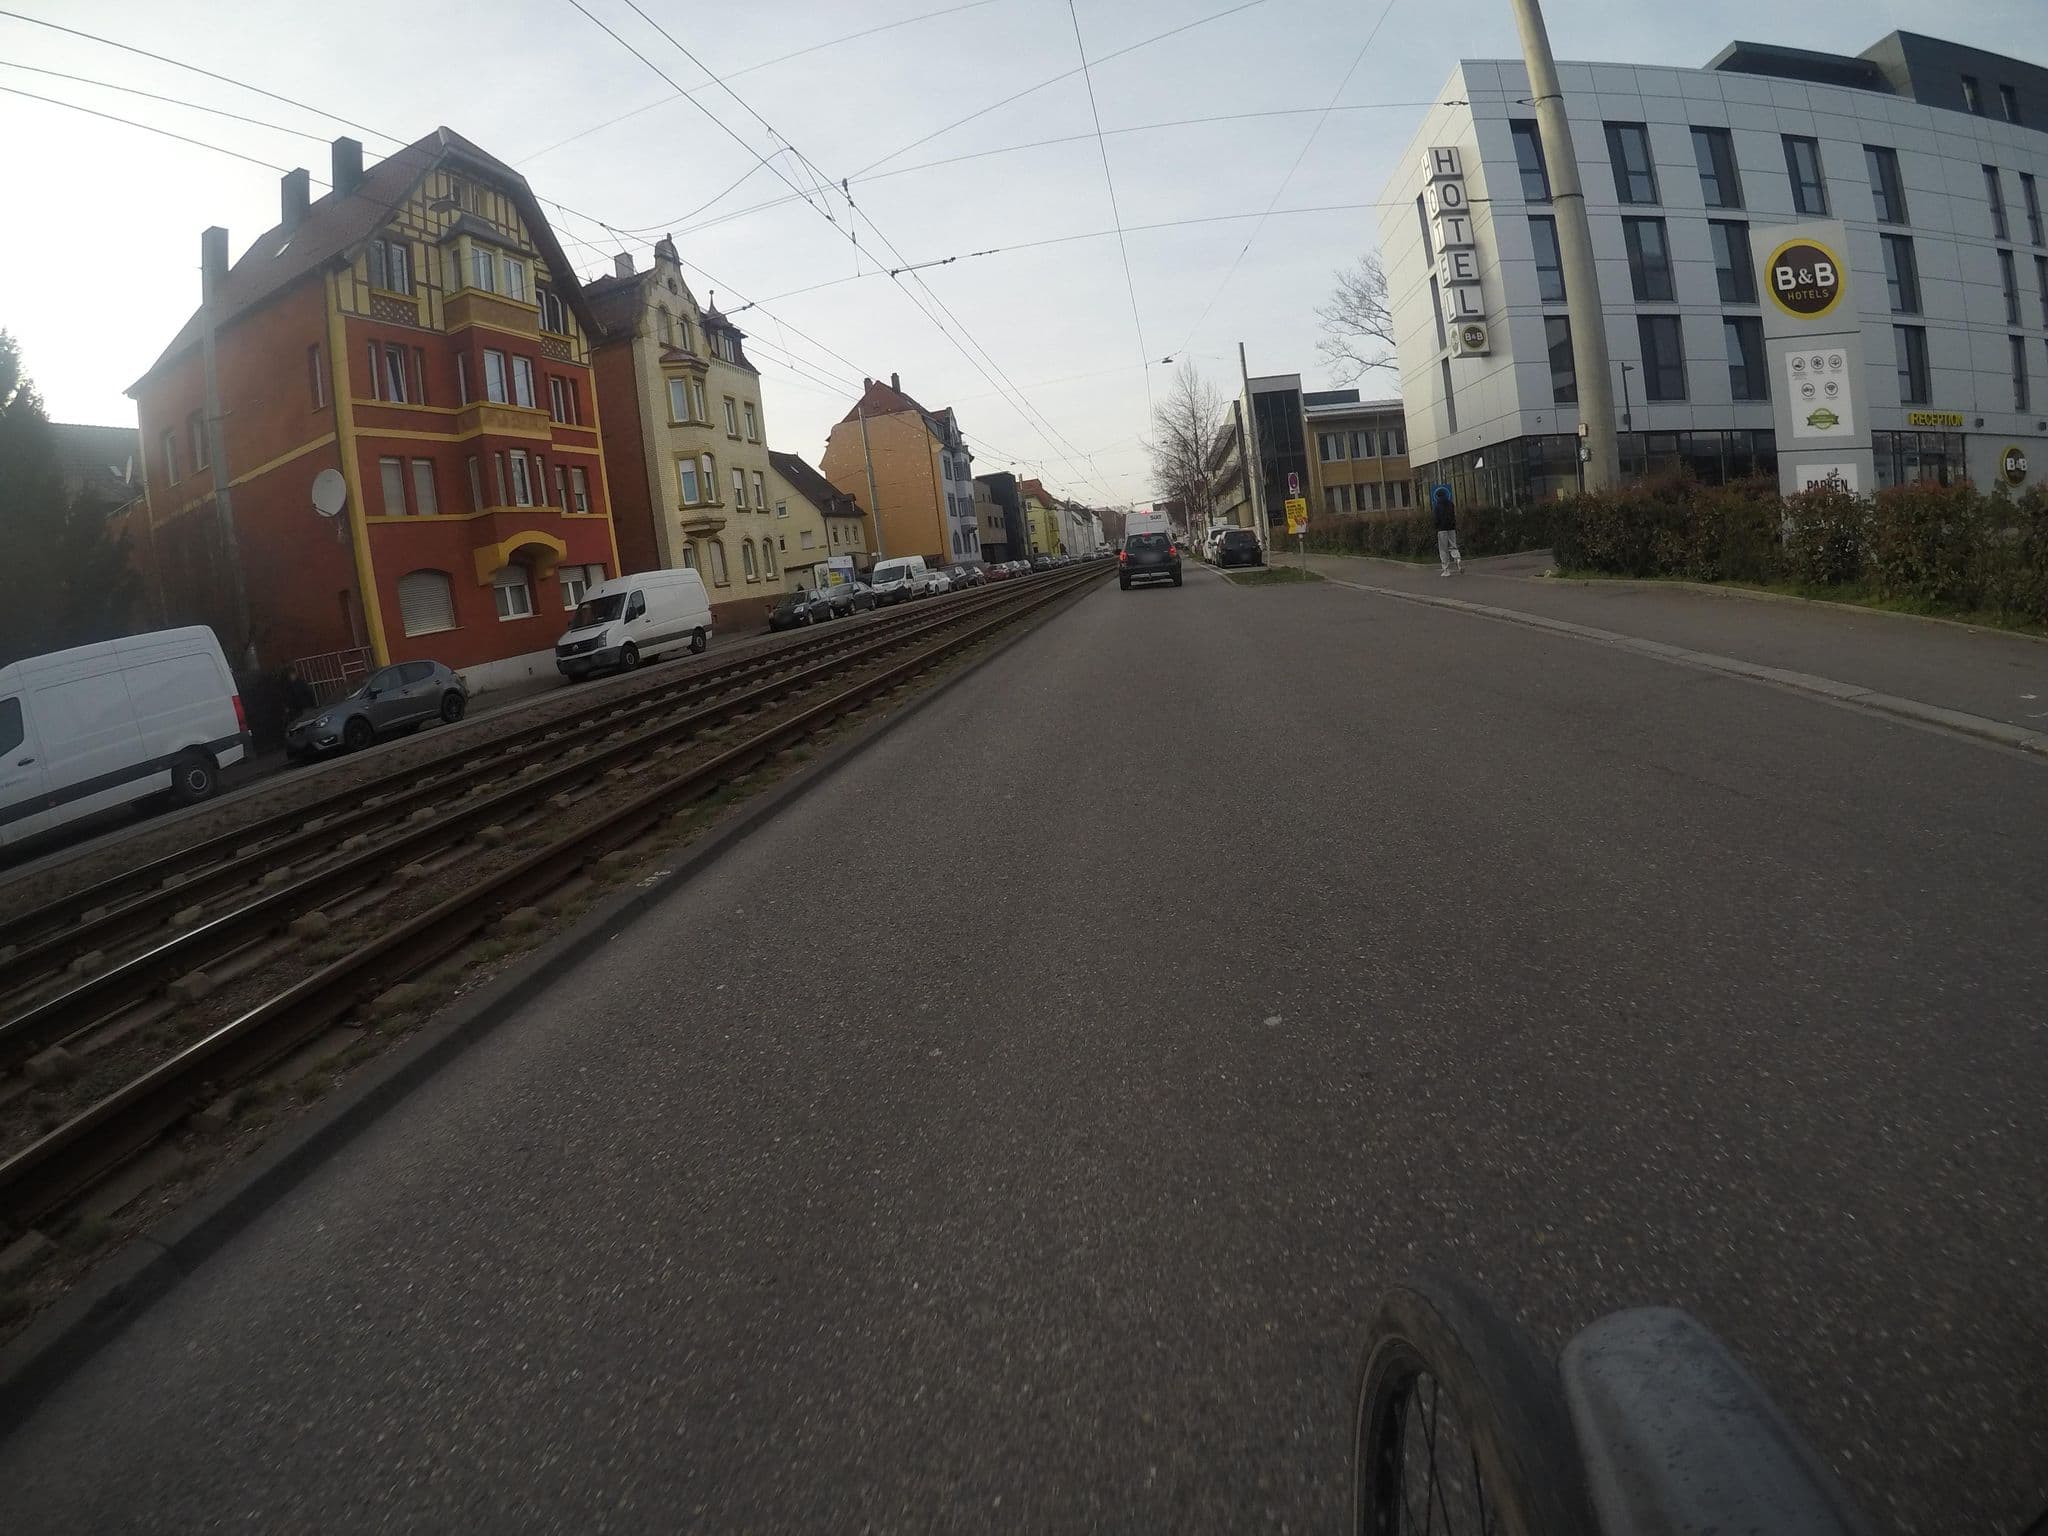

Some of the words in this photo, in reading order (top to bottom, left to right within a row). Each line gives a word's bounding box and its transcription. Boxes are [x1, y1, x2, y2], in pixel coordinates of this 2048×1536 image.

[1434, 149, 1478, 314] HOTEL
[1776, 262, 1835, 290] B&B
[1787, 289, 1829, 301] HOTELS
[1464, 332, 1484, 341] B&B
[1909, 411, 1964, 427] RECEPTION
[2006, 457, 2028, 471] B&B
